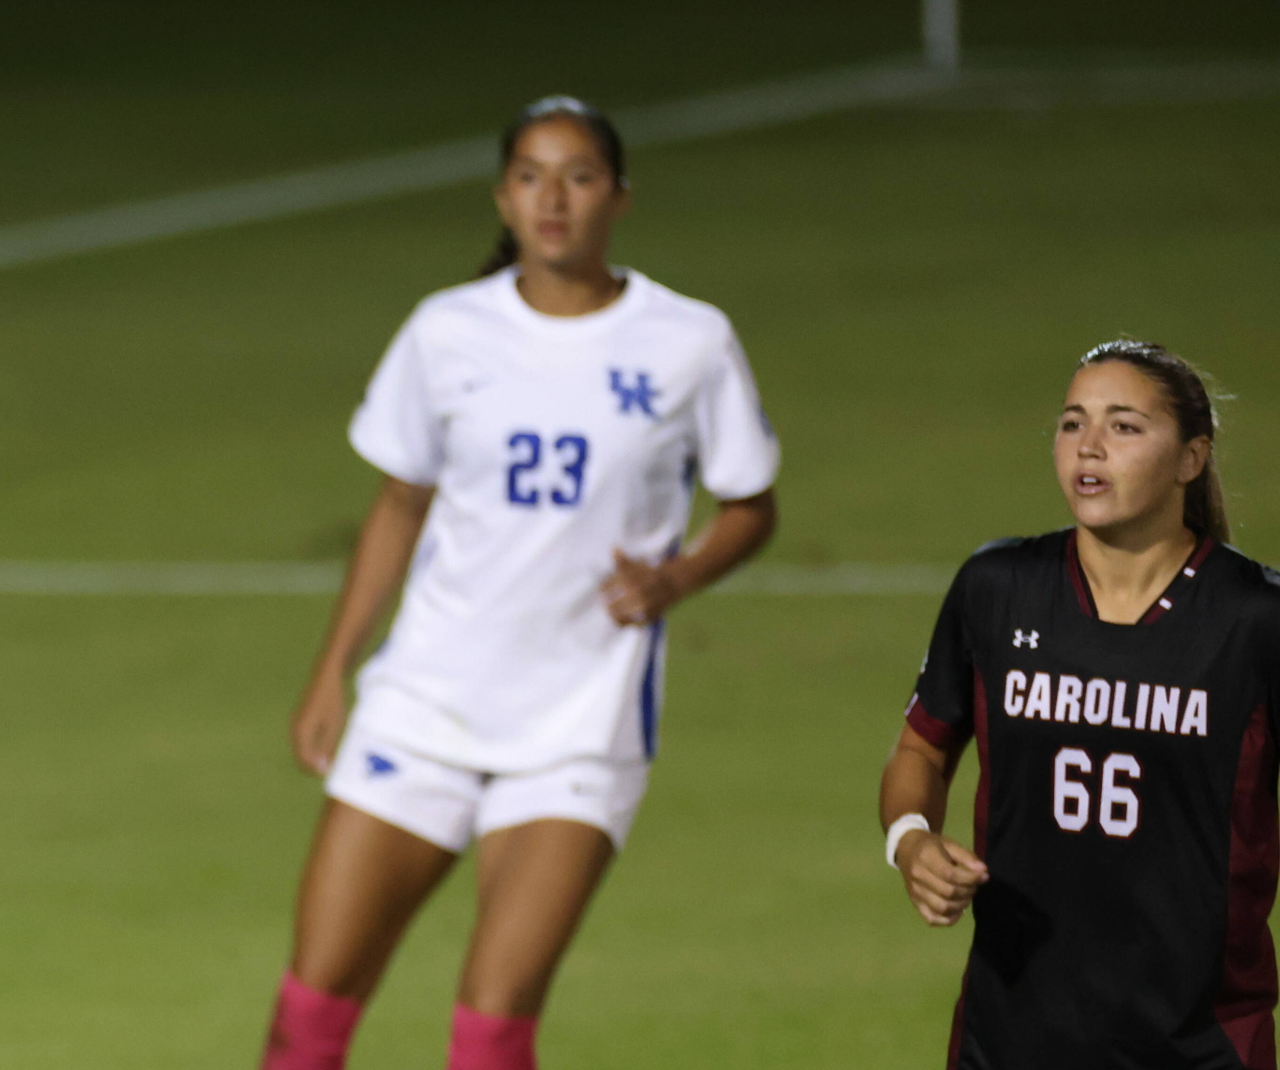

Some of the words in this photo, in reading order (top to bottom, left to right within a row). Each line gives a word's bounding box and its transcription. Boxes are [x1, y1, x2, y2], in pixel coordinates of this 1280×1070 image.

[506, 431, 590, 506] 23
[1003, 669, 1209, 737] CAROLINA
[1053, 746, 1141, 838] 66
